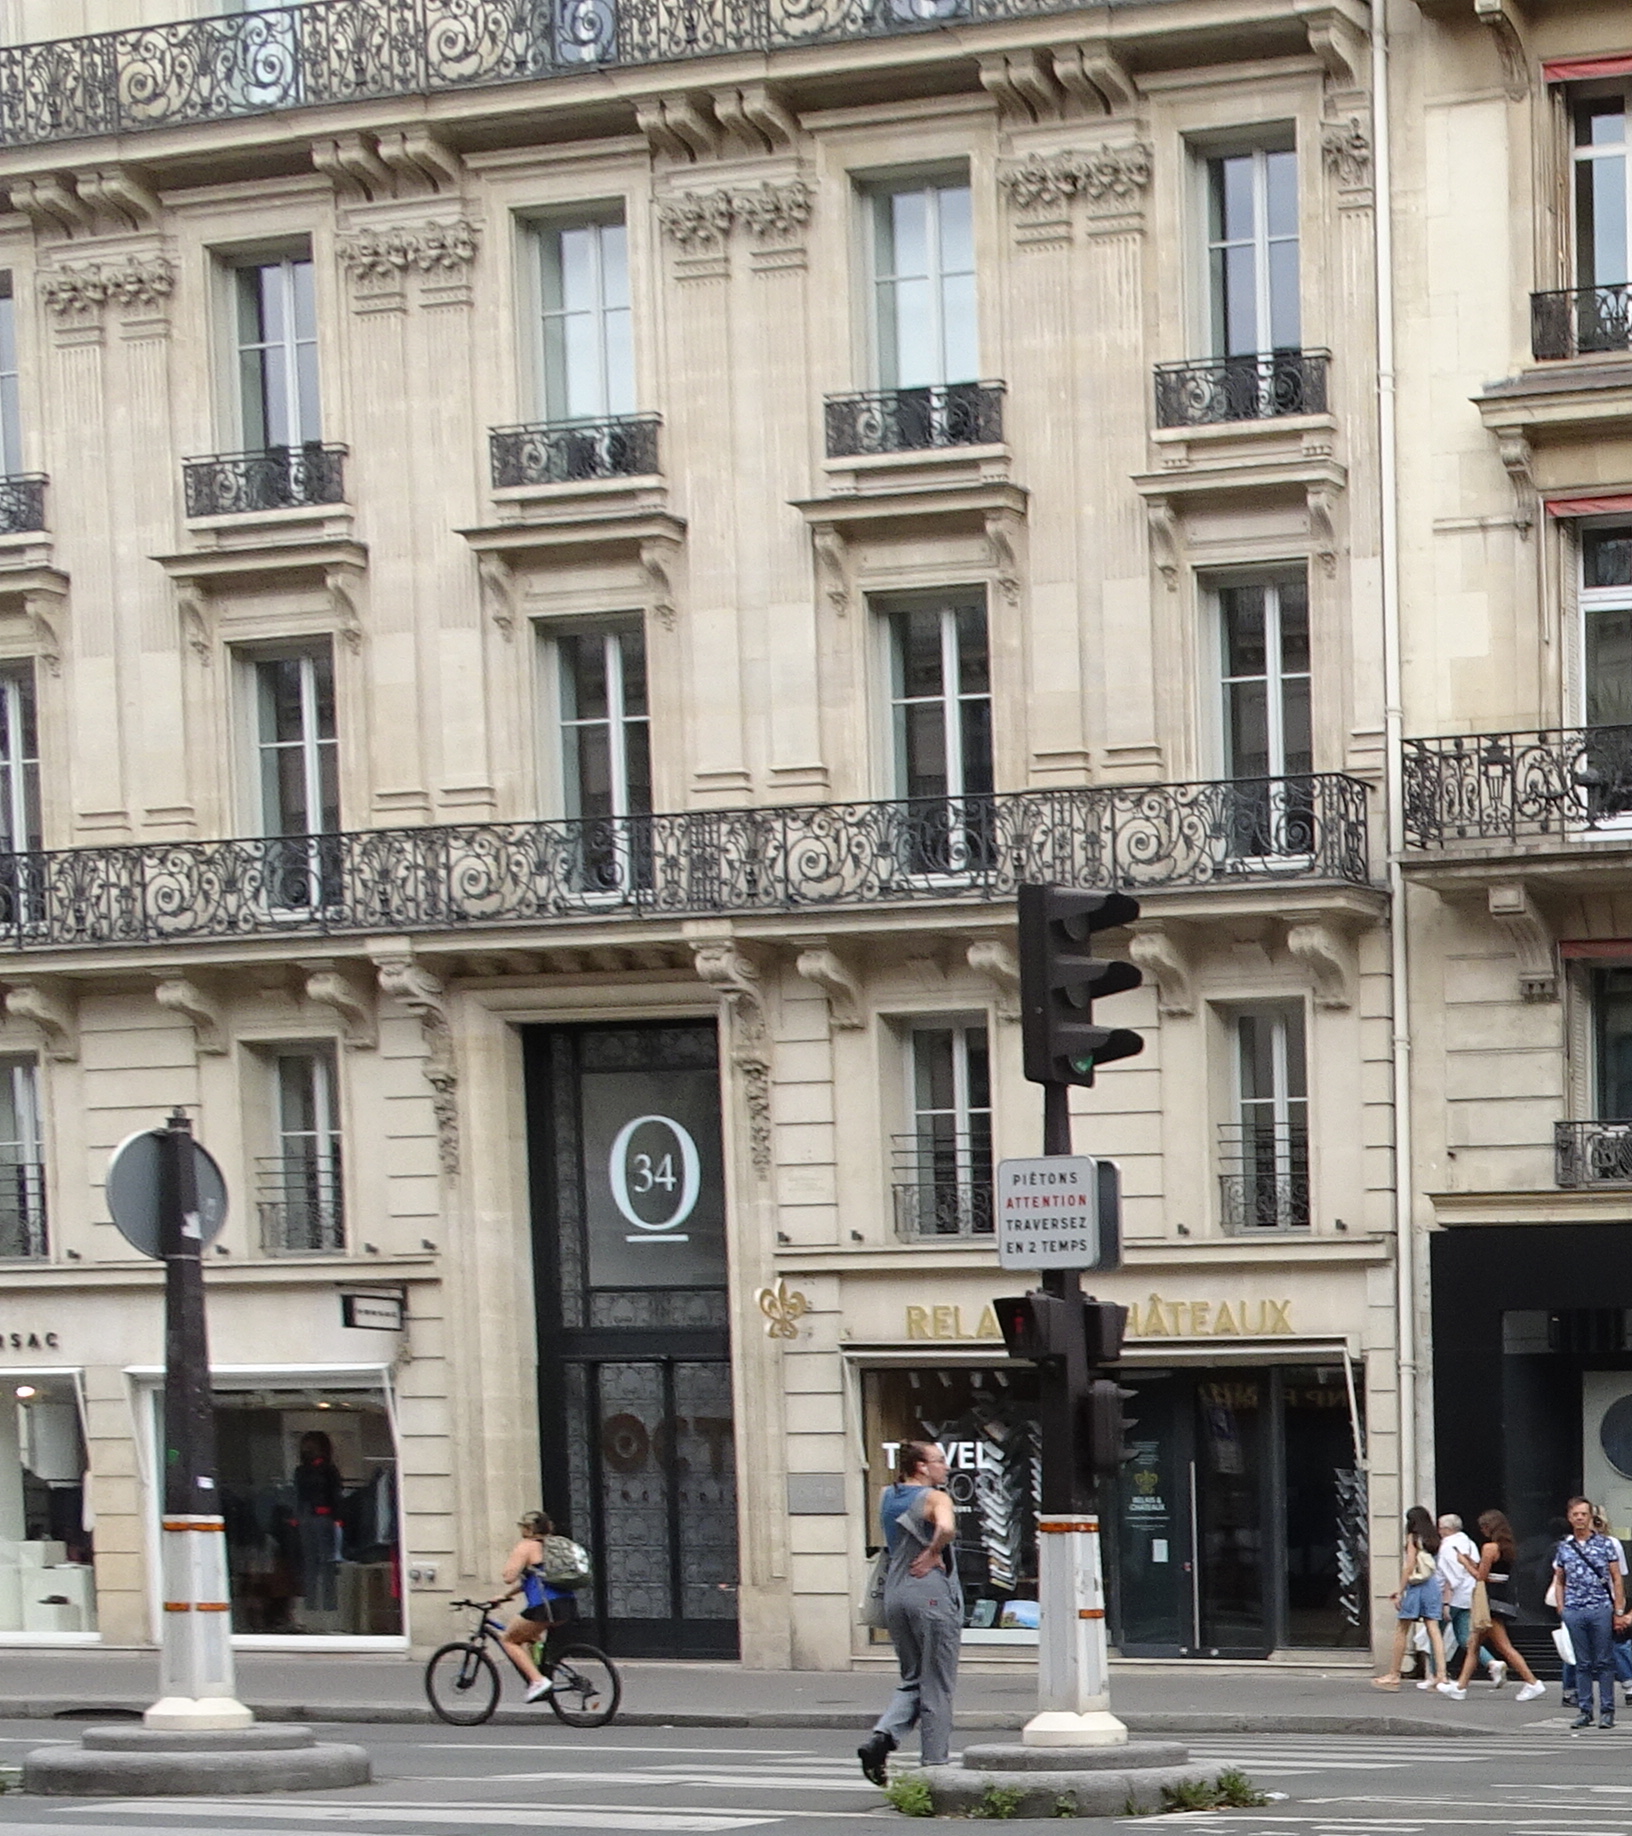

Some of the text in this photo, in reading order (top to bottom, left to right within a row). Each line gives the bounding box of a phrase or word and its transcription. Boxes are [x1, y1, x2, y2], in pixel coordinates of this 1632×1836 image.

[633, 1153, 676, 1193] 34
[1013, 1171, 1078, 1186] PIÉTONS
[1006, 1194, 1087, 1209] ATTENTION
[1006, 1217, 1087, 1231] TRAVERSEZ
[1006, 1239, 1088, 1254] EN 2 TEMPS
[906, 1293, 1296, 1340] RELA HÂTEAUX
[882, 1441, 993, 1470] TVEL
